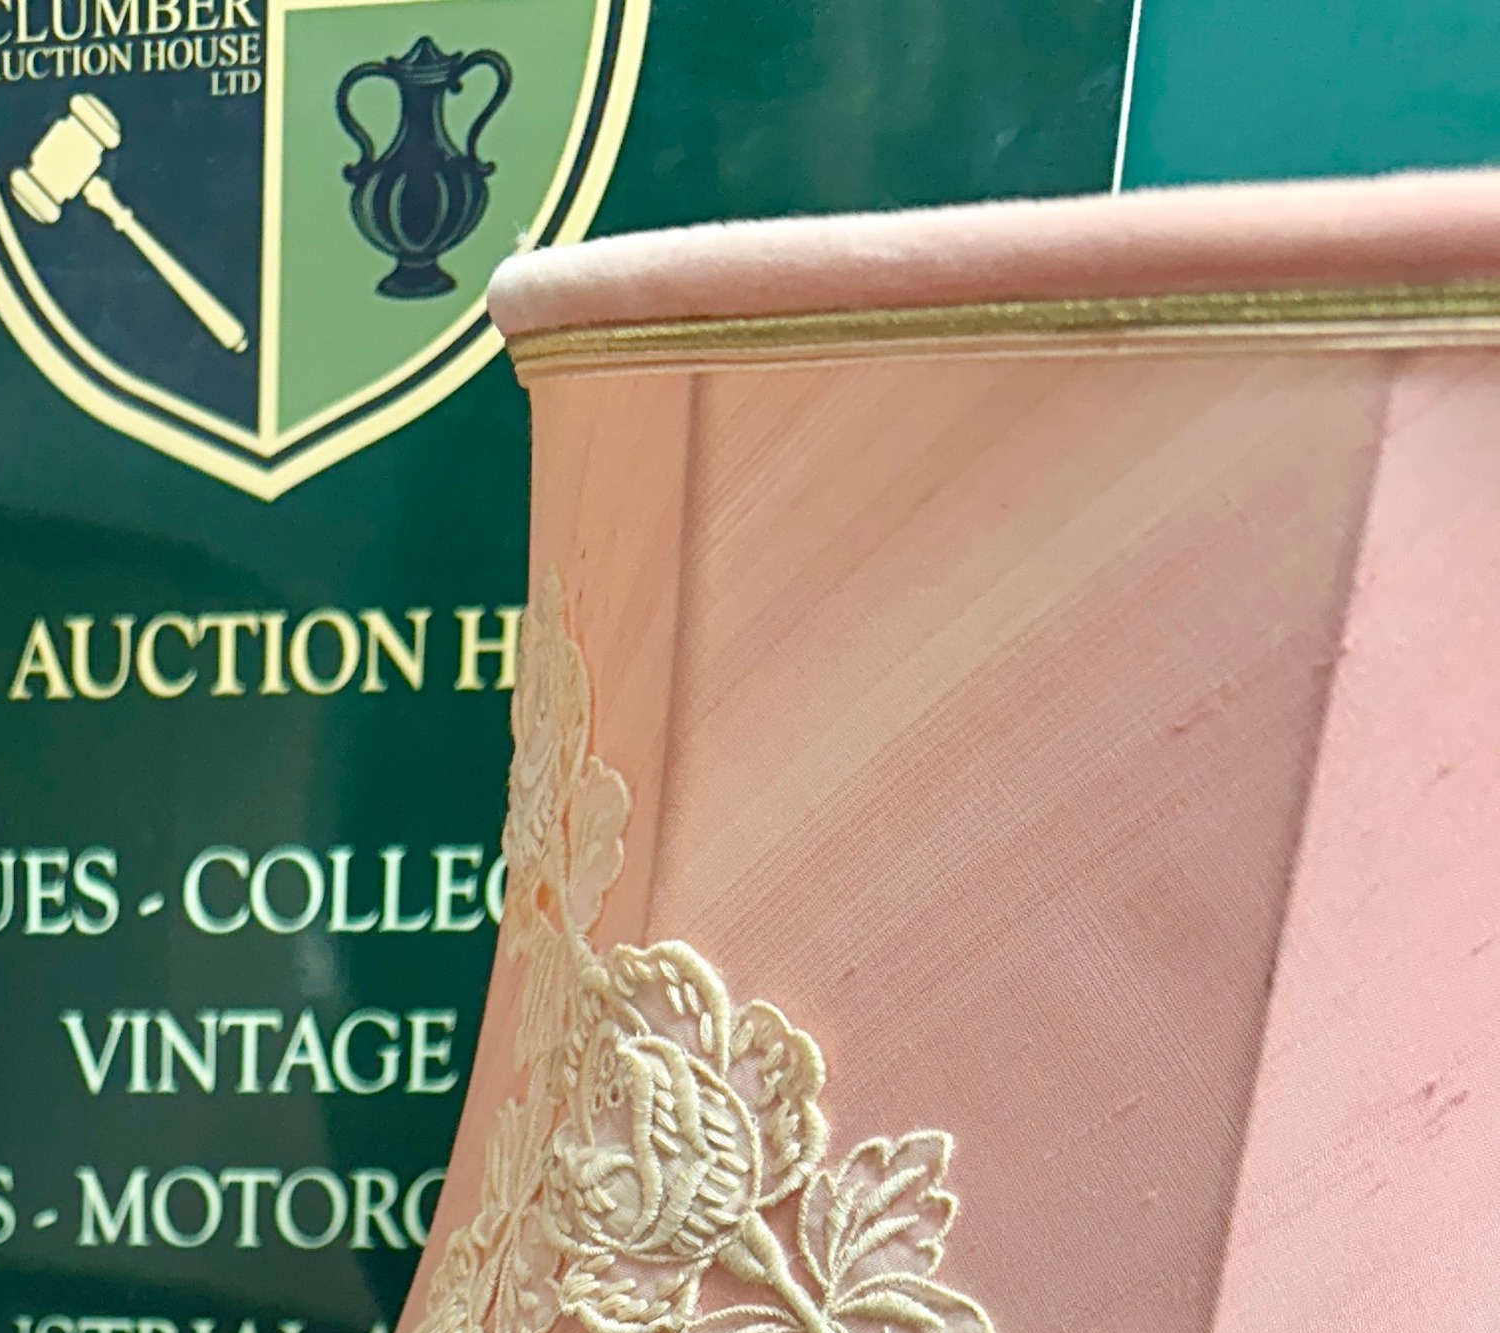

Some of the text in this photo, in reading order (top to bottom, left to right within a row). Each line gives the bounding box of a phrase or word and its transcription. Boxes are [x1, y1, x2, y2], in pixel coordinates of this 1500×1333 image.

[142, 32, 262, 73] HOUSE
[210, 69, 262, 96] LTD
[8, 608, 433, 702] AUCTION
[58, 1007, 460, 1096] VINTAGE
